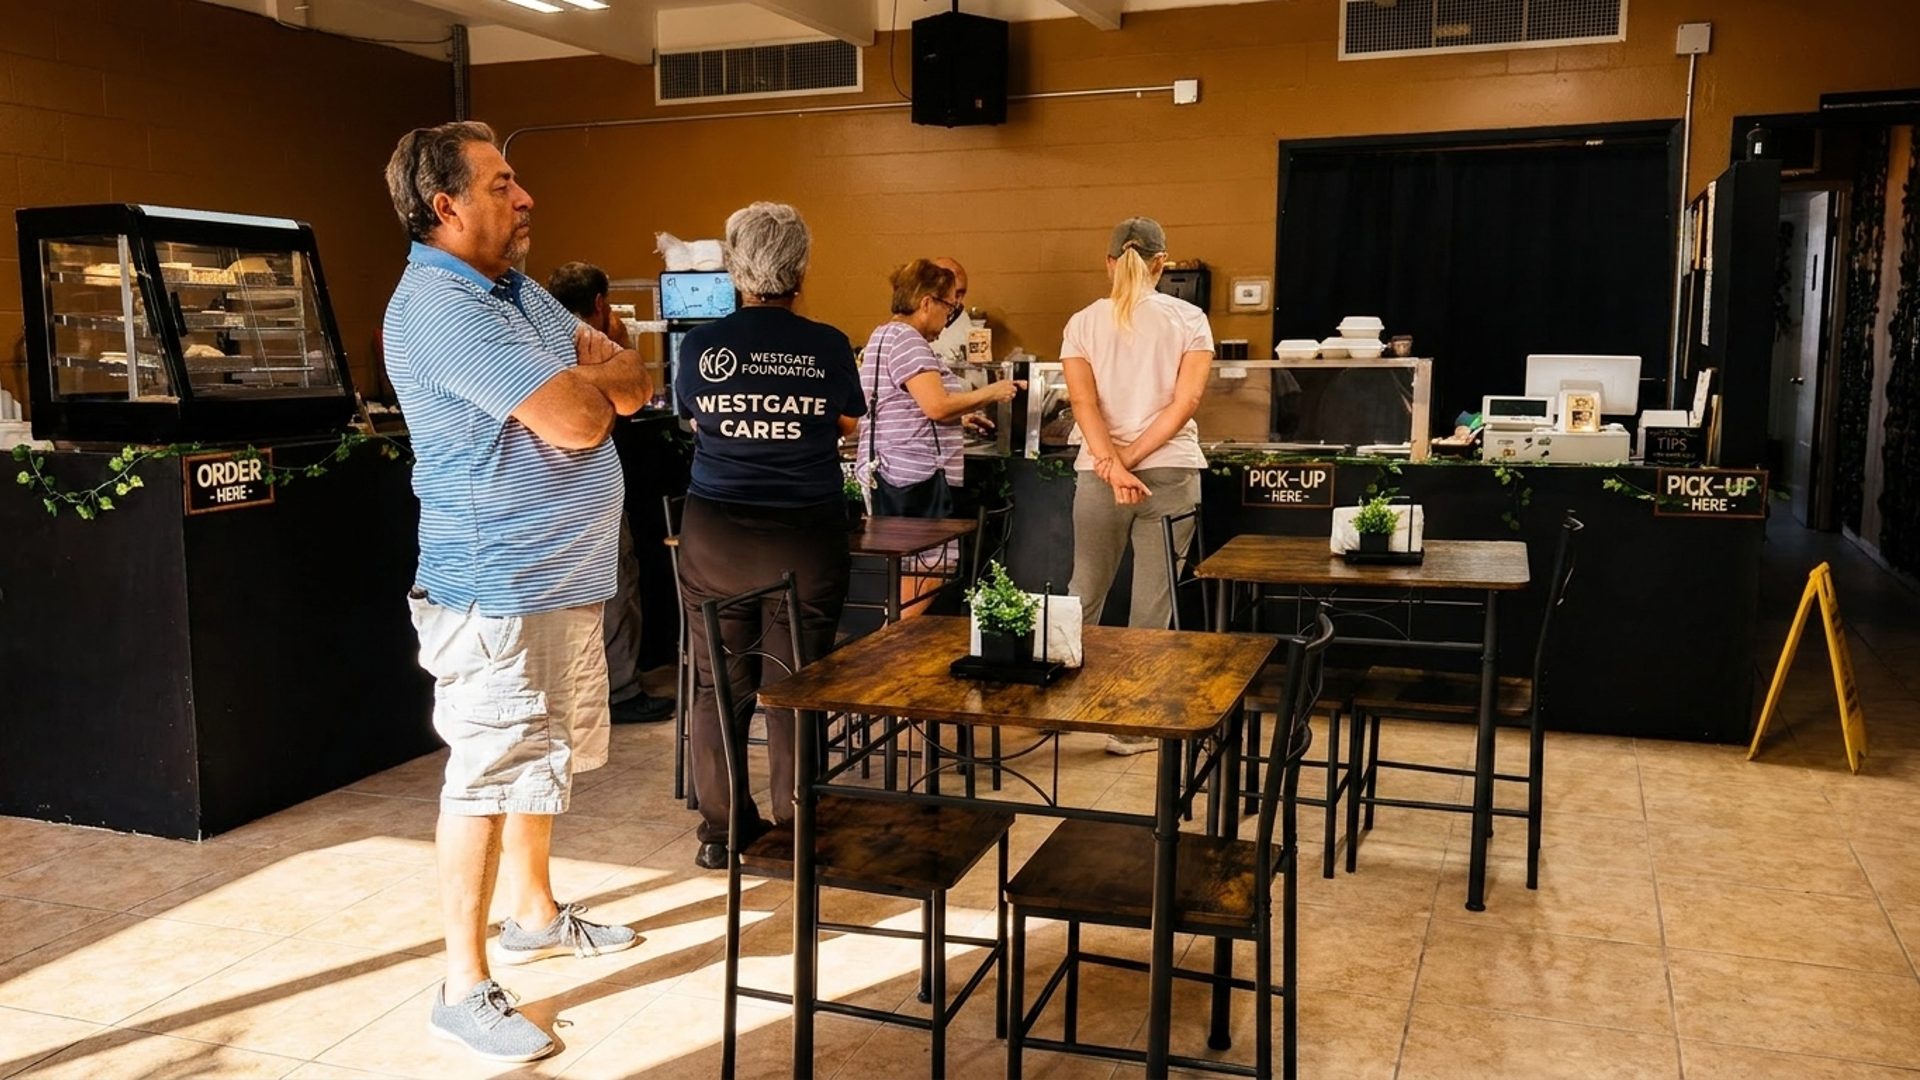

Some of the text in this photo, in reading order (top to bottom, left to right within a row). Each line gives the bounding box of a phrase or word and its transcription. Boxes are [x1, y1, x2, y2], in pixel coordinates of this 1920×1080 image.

[750, 352, 816, 366] WESTGATE
[741, 364, 825, 379] FOUNDATION
[696, 394, 827, 416] WESTGATE
[720, 419, 801, 440] CARES
[1658, 437, 1688, 451] TIPS
[196, 458, 262, 488] ORDER
[1249, 469, 1326, 488] PICK-UP
[1667, 475, 1757, 497] PICK-UP
